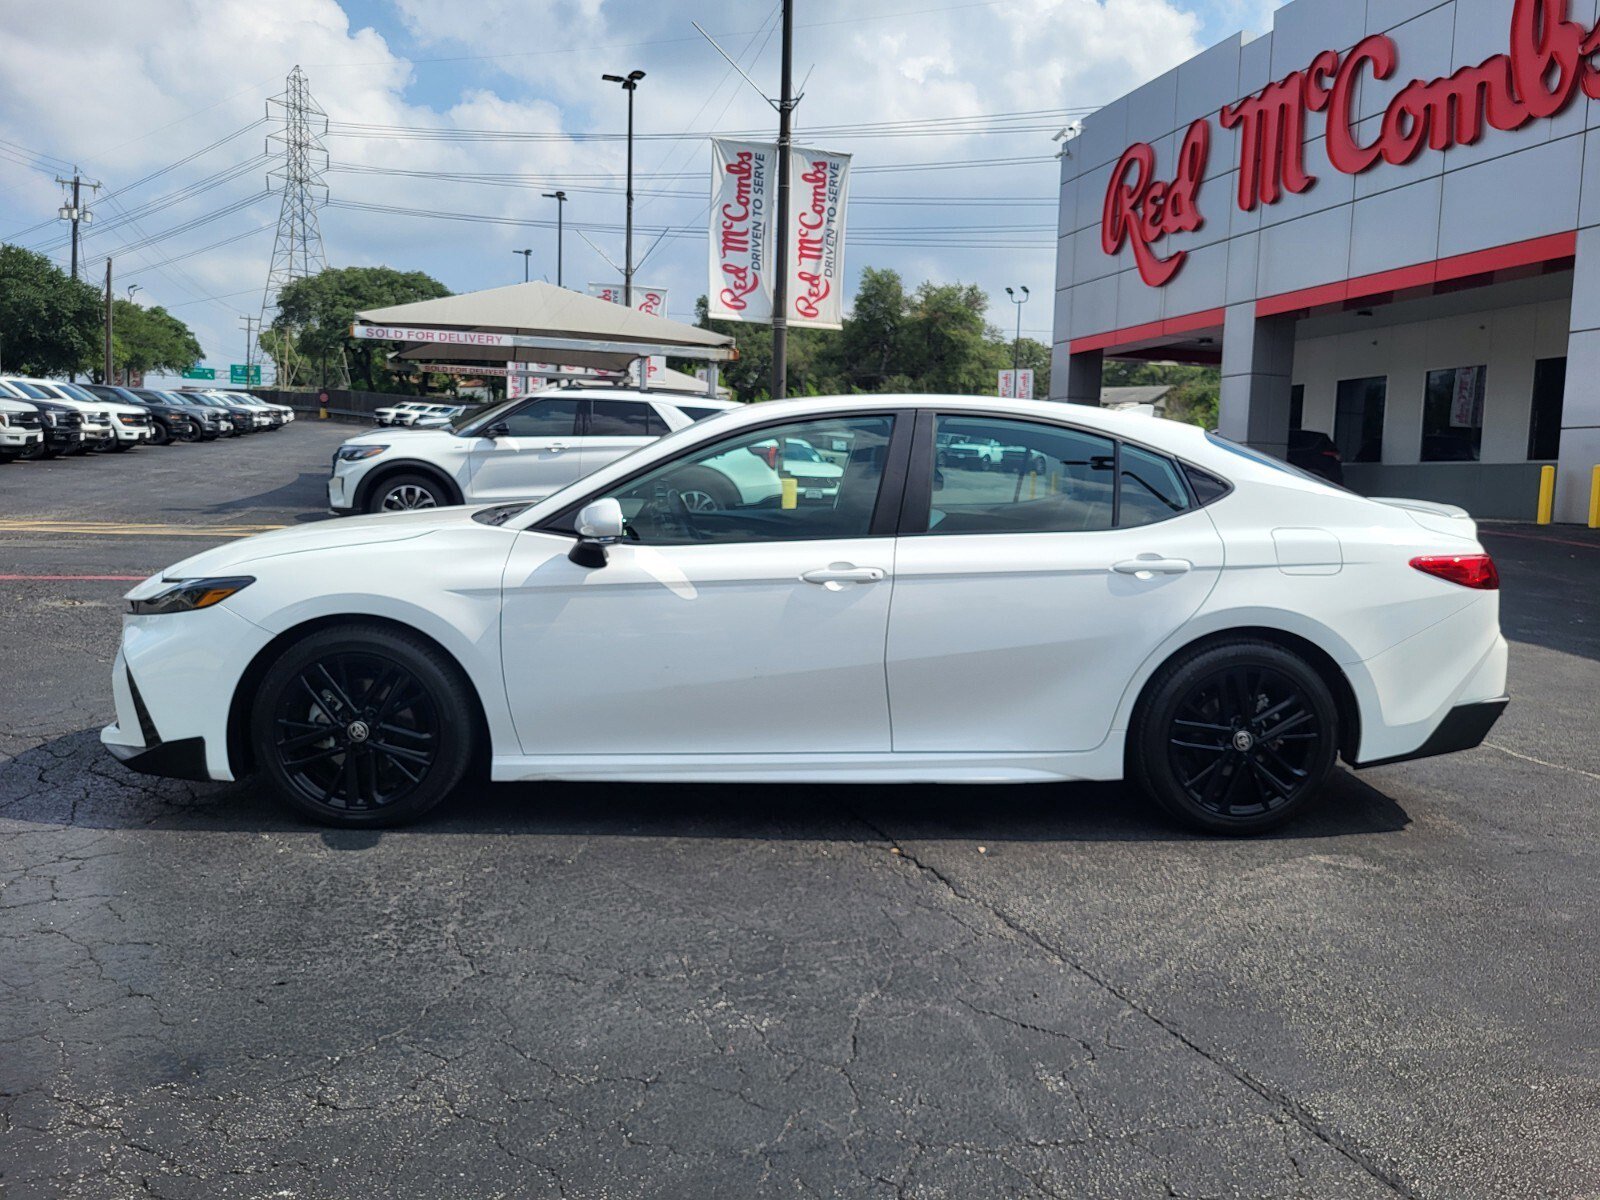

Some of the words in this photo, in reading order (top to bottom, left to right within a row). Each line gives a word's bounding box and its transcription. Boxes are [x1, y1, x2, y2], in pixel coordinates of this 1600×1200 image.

[753, 152, 765, 195] SERVE
[828, 162, 840, 204] SERVE
[721, 151, 754, 259] McCombs
[752, 198, 763, 219] TO
[798, 161, 828, 267] McCombs
[826, 206, 837, 227] TO
[1102, 119, 1209, 287] Red
[751, 221, 763, 271] DRIVEN
[824, 229, 836, 278] DRIVEN
[720, 264, 759, 311] Red
[795, 271, 830, 318] Red
[366, 328, 403, 339] SOLD
[407, 331, 435, 341] FOR
[439, 332, 503, 344] DELIVERY
[424, 365, 449, 373] SOLD
